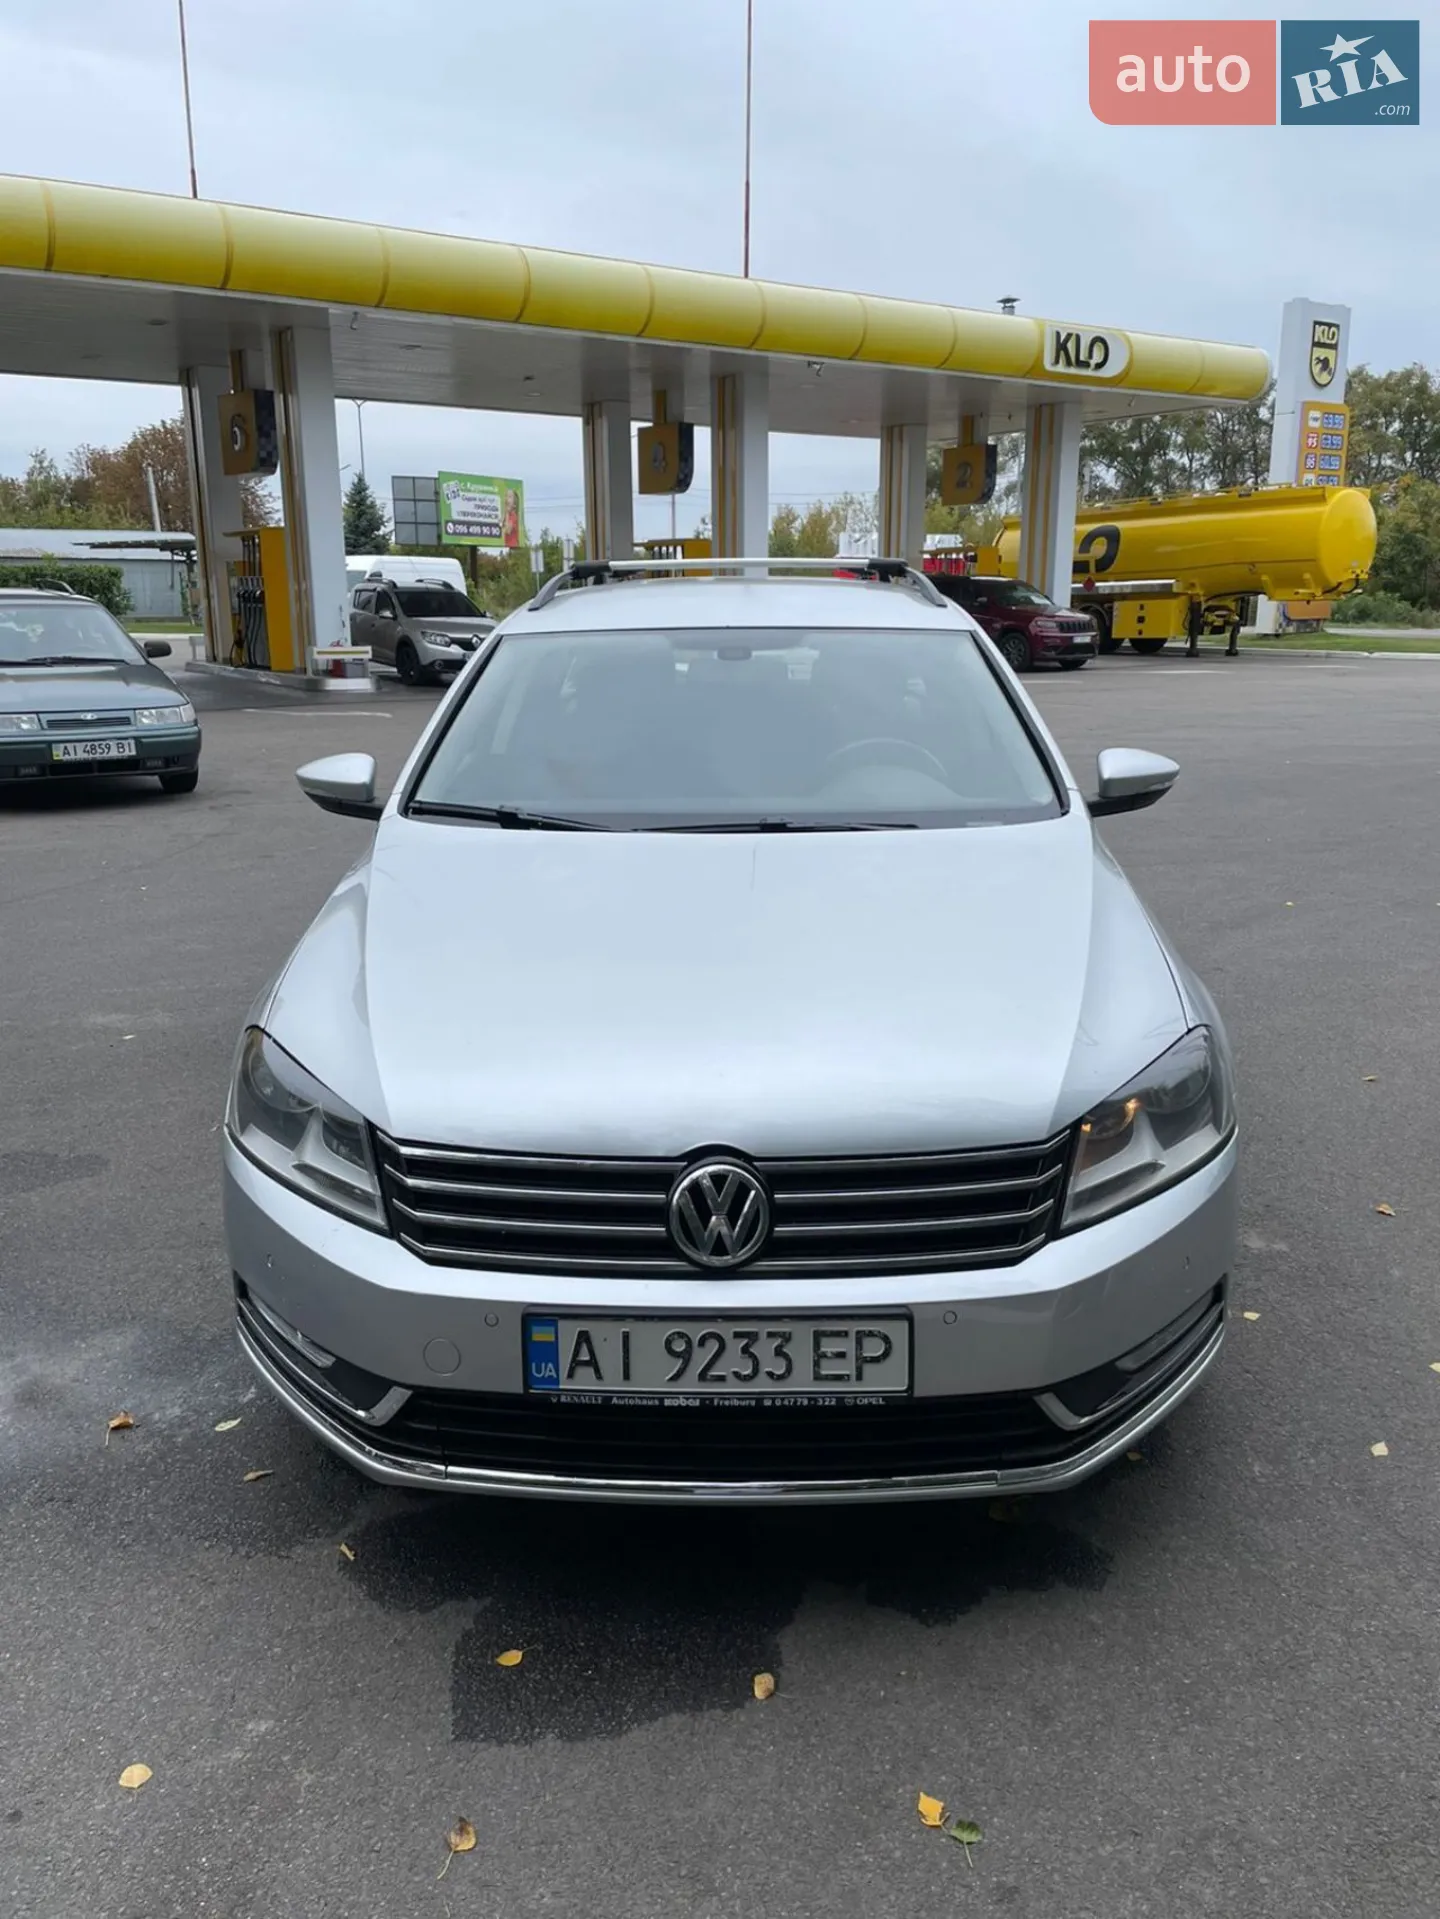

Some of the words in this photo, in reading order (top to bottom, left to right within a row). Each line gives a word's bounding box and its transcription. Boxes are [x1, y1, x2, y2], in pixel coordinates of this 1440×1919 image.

[1314, 324, 1338, 344] KLO
[1053, 330, 1111, 372] KLO
[82, 743, 111, 756] 4859
[565, 1328, 632, 1382] AI
[663, 1328, 793, 1383] 9233
[812, 1328, 894, 1382] EP
[531, 1362, 558, 1379] UA
[559, 1396, 602, 1405] RENAULT
[611, 1396, 660, 1406] Autohaus
[856, 1396, 886, 1406] OPEL
